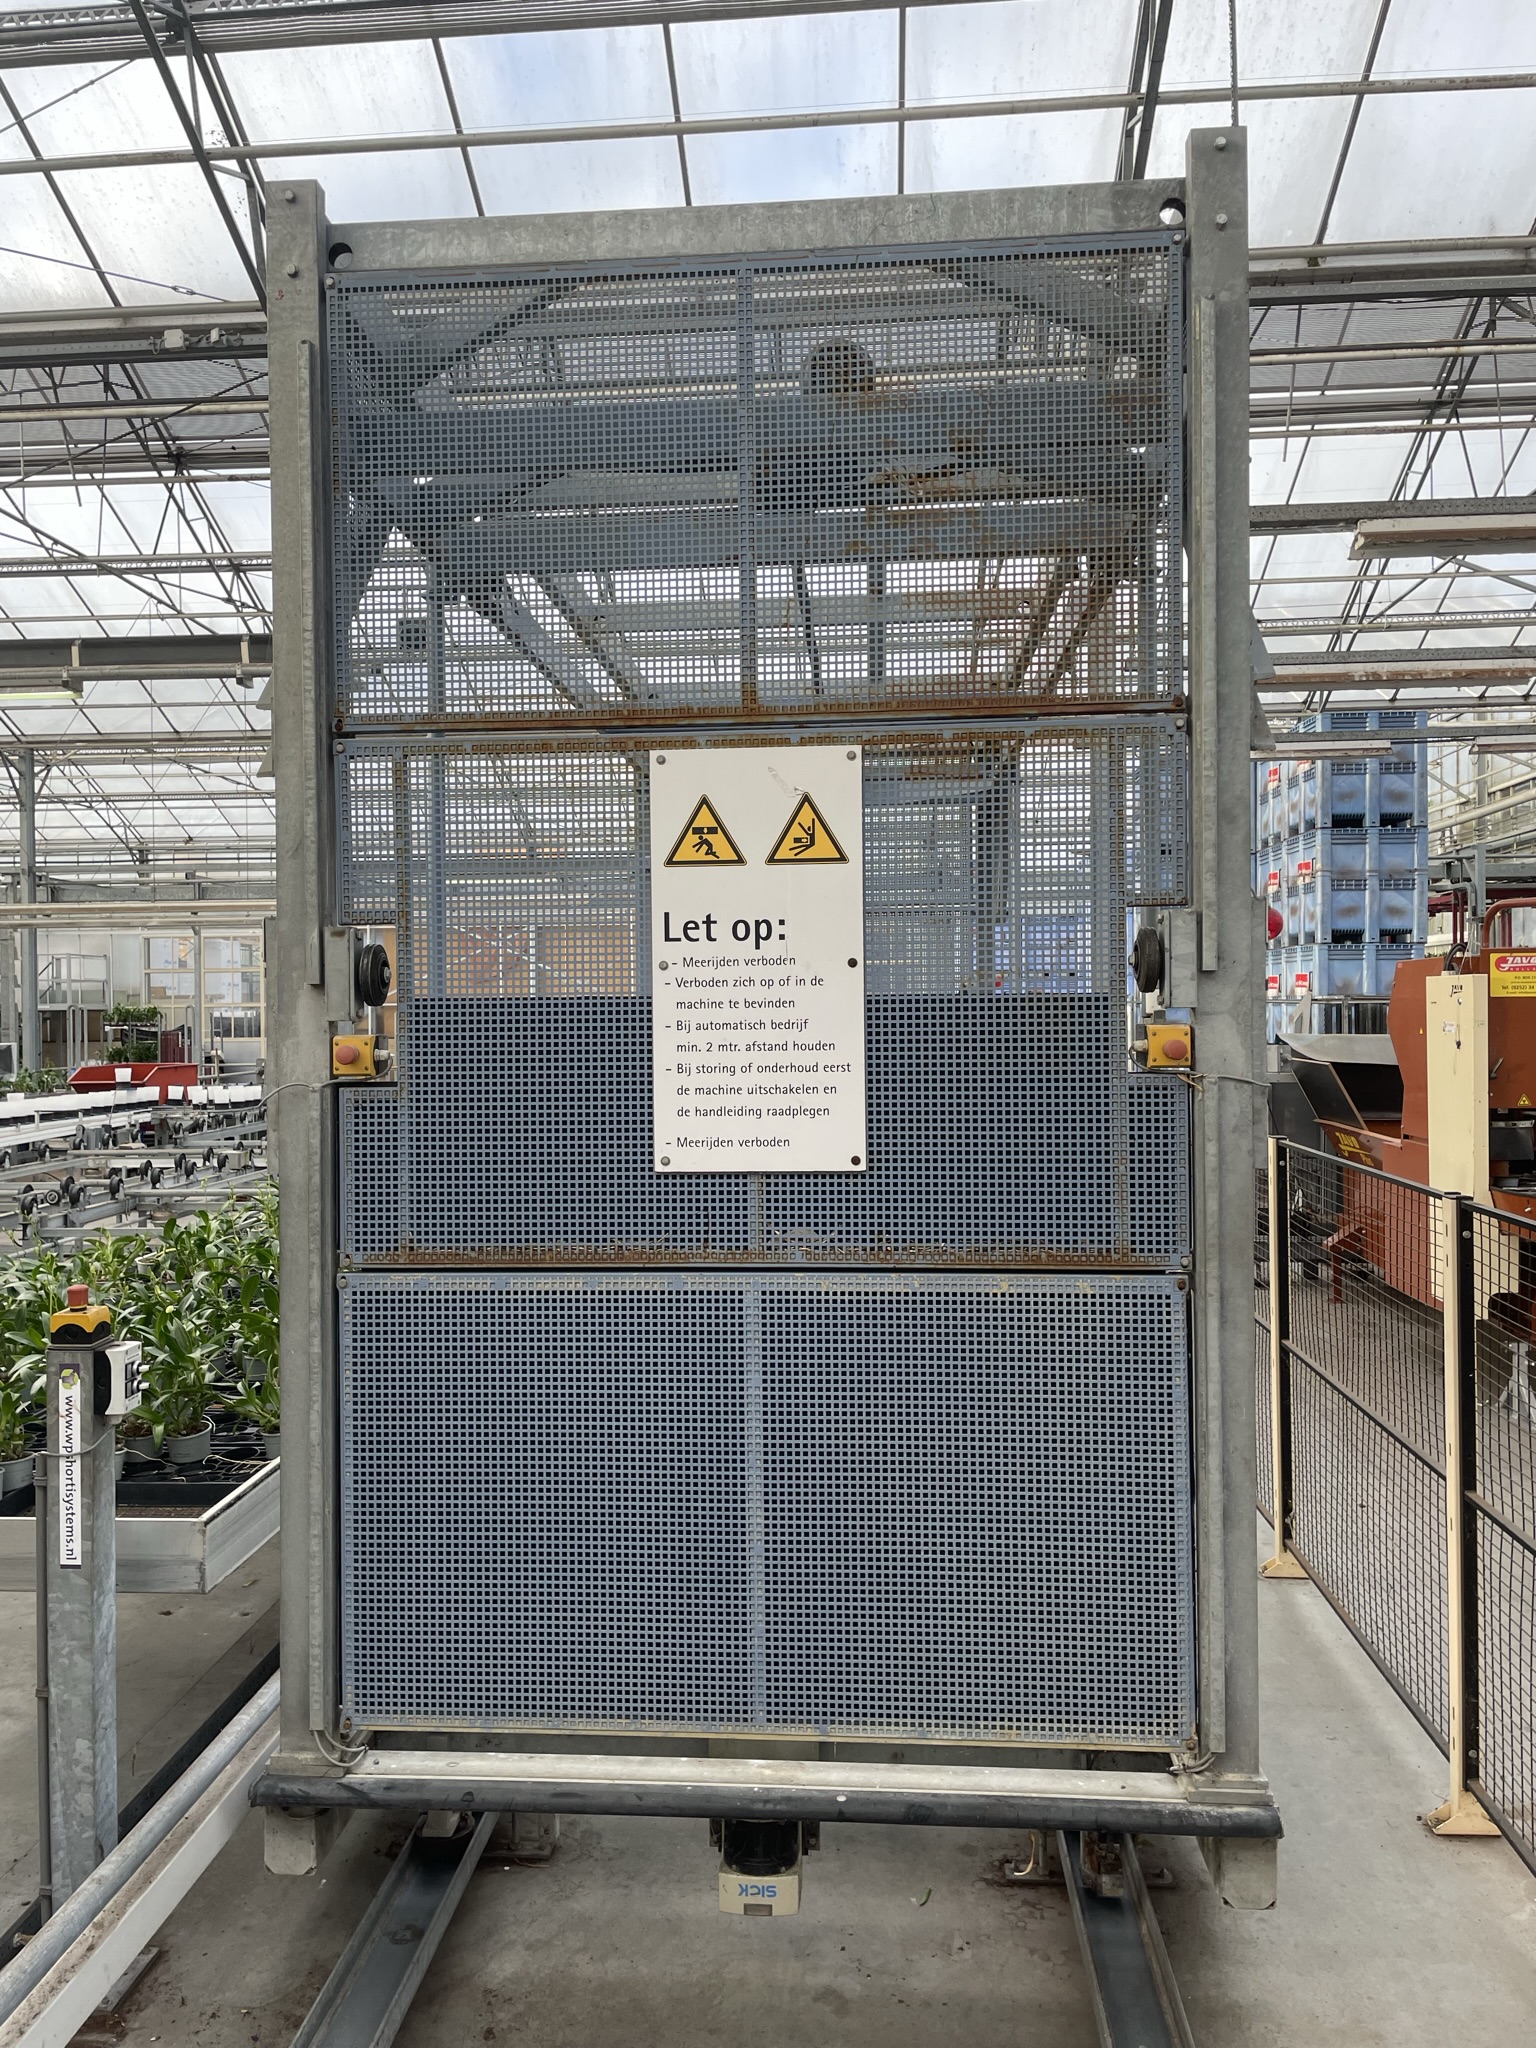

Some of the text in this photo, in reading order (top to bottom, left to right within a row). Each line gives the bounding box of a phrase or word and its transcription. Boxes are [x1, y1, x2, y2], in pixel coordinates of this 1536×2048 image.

[664, 912, 788, 951] Let op:
[682, 955, 740, 971] Meerijden
[744, 955, 796, 967] verboden
[675, 976, 729, 989] Verboden
[733, 975, 756, 988] zich
[760, 978, 774, 990] op
[779, 975, 791, 987] of
[796, 976, 806, 987] in
[811, 975, 824, 987] de
[676, 997, 796, 1010] machine te bevinden
[676, 1019, 691, 1034] Bij
[696, 1018, 766, 1031] automatisch
[771, 1018, 810, 1033] bedrijf
[676, 1039, 836, 1053] min. 2 mtr. afstand houden
[676, 1062, 692, 1077] Bij
[696, 1062, 736, 1077] storing
[741, 1061, 753, 1074] of
[757, 1061, 819, 1074] onderhoud
[823, 1062, 852, 1073] eerst
[676, 1083, 837, 1096] de machine uitschakelen en
[676, 1104, 830, 1120] de handleiding raadplegen
[676, 1136, 734, 1151] Meerijden
[738, 1136, 791, 1148] verboden
[738, 1884, 777, 1898] SICK
